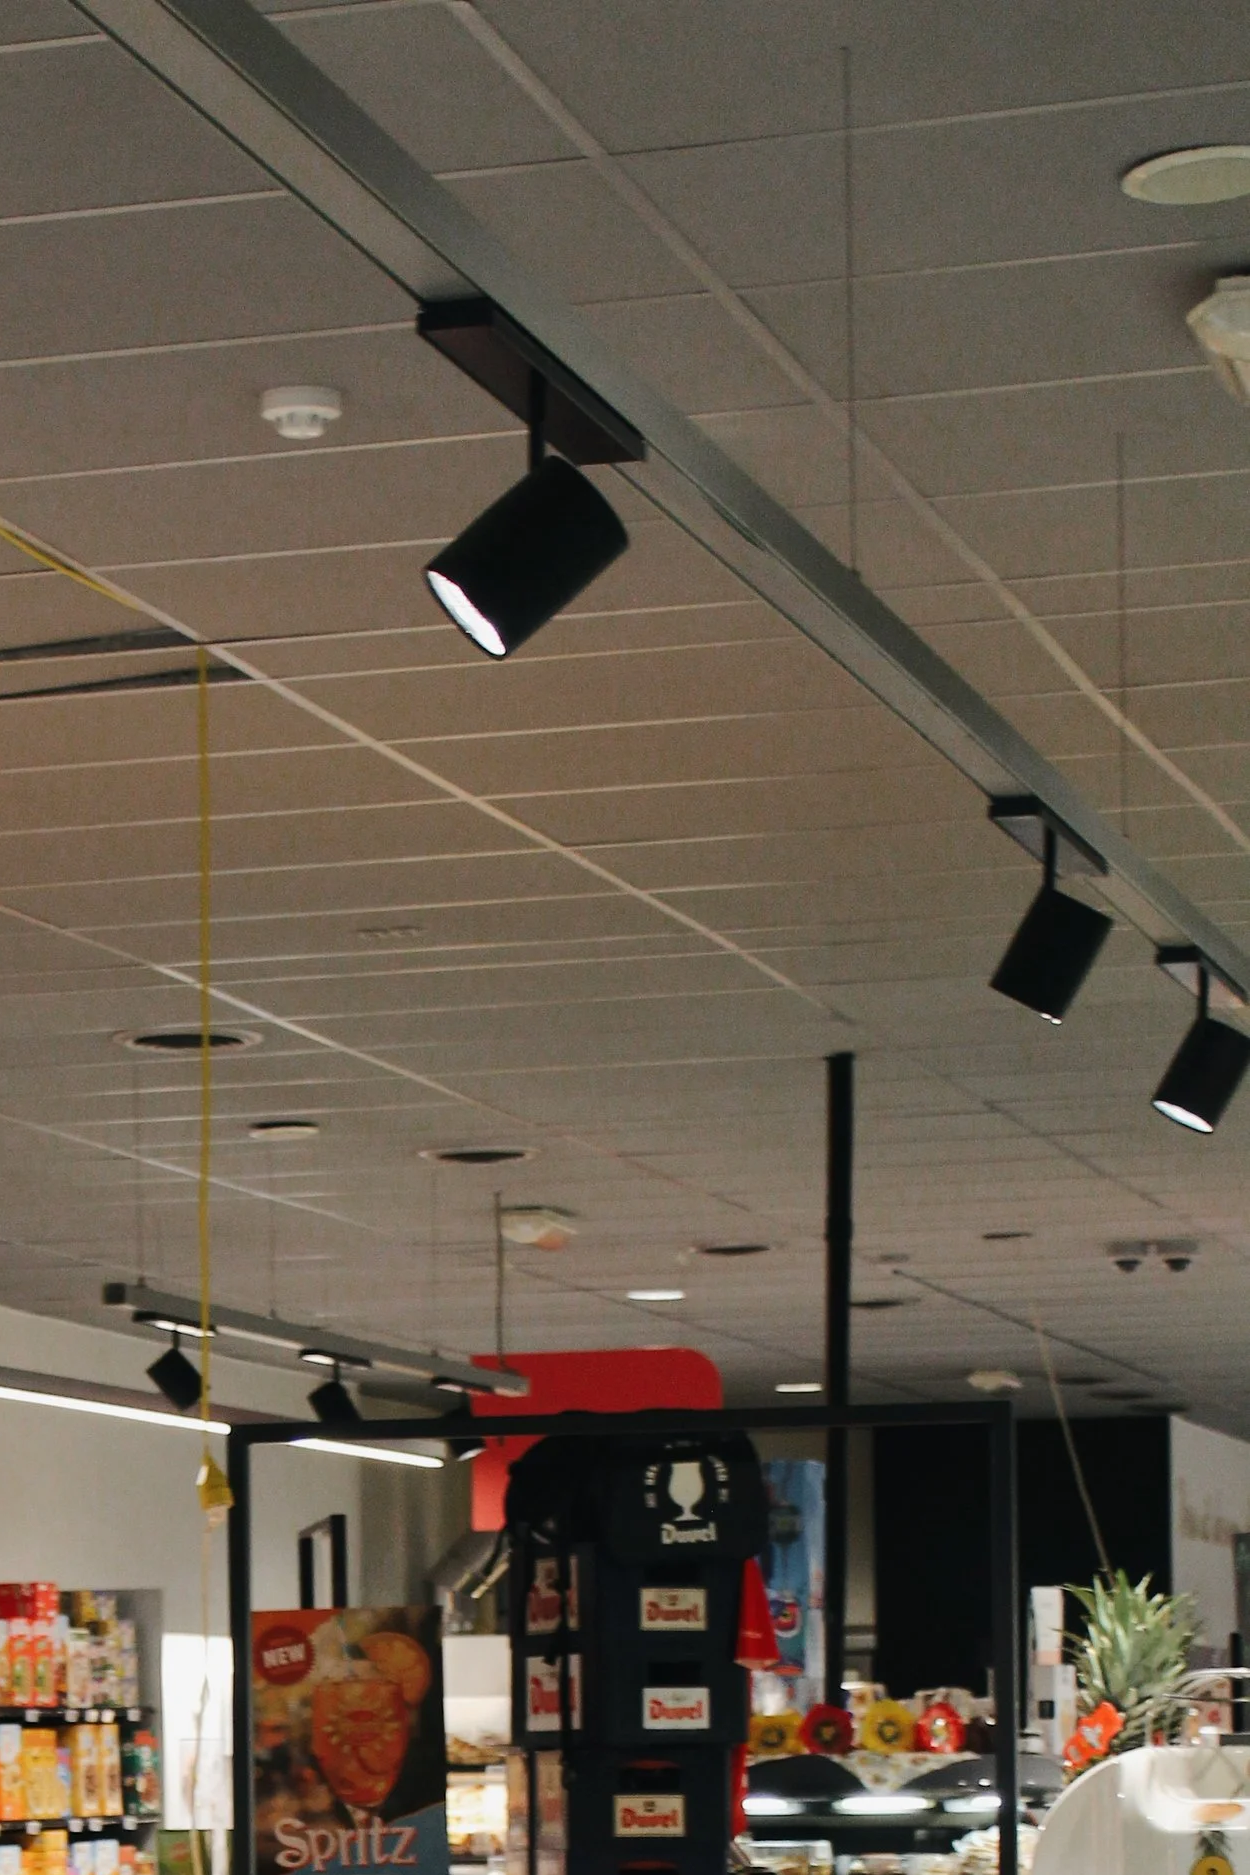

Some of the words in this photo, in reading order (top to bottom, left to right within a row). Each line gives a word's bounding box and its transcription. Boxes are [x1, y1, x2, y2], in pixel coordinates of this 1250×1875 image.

[661, 1521, 717, 1545] Duvel
[647, 1600, 699, 1622] Duvel
[262, 1643, 306, 1668] NEW
[650, 1699, 703, 1720] Duvel
[620, 1807, 679, 1829] Duvel
[274, 1815, 418, 1873] Spritz
